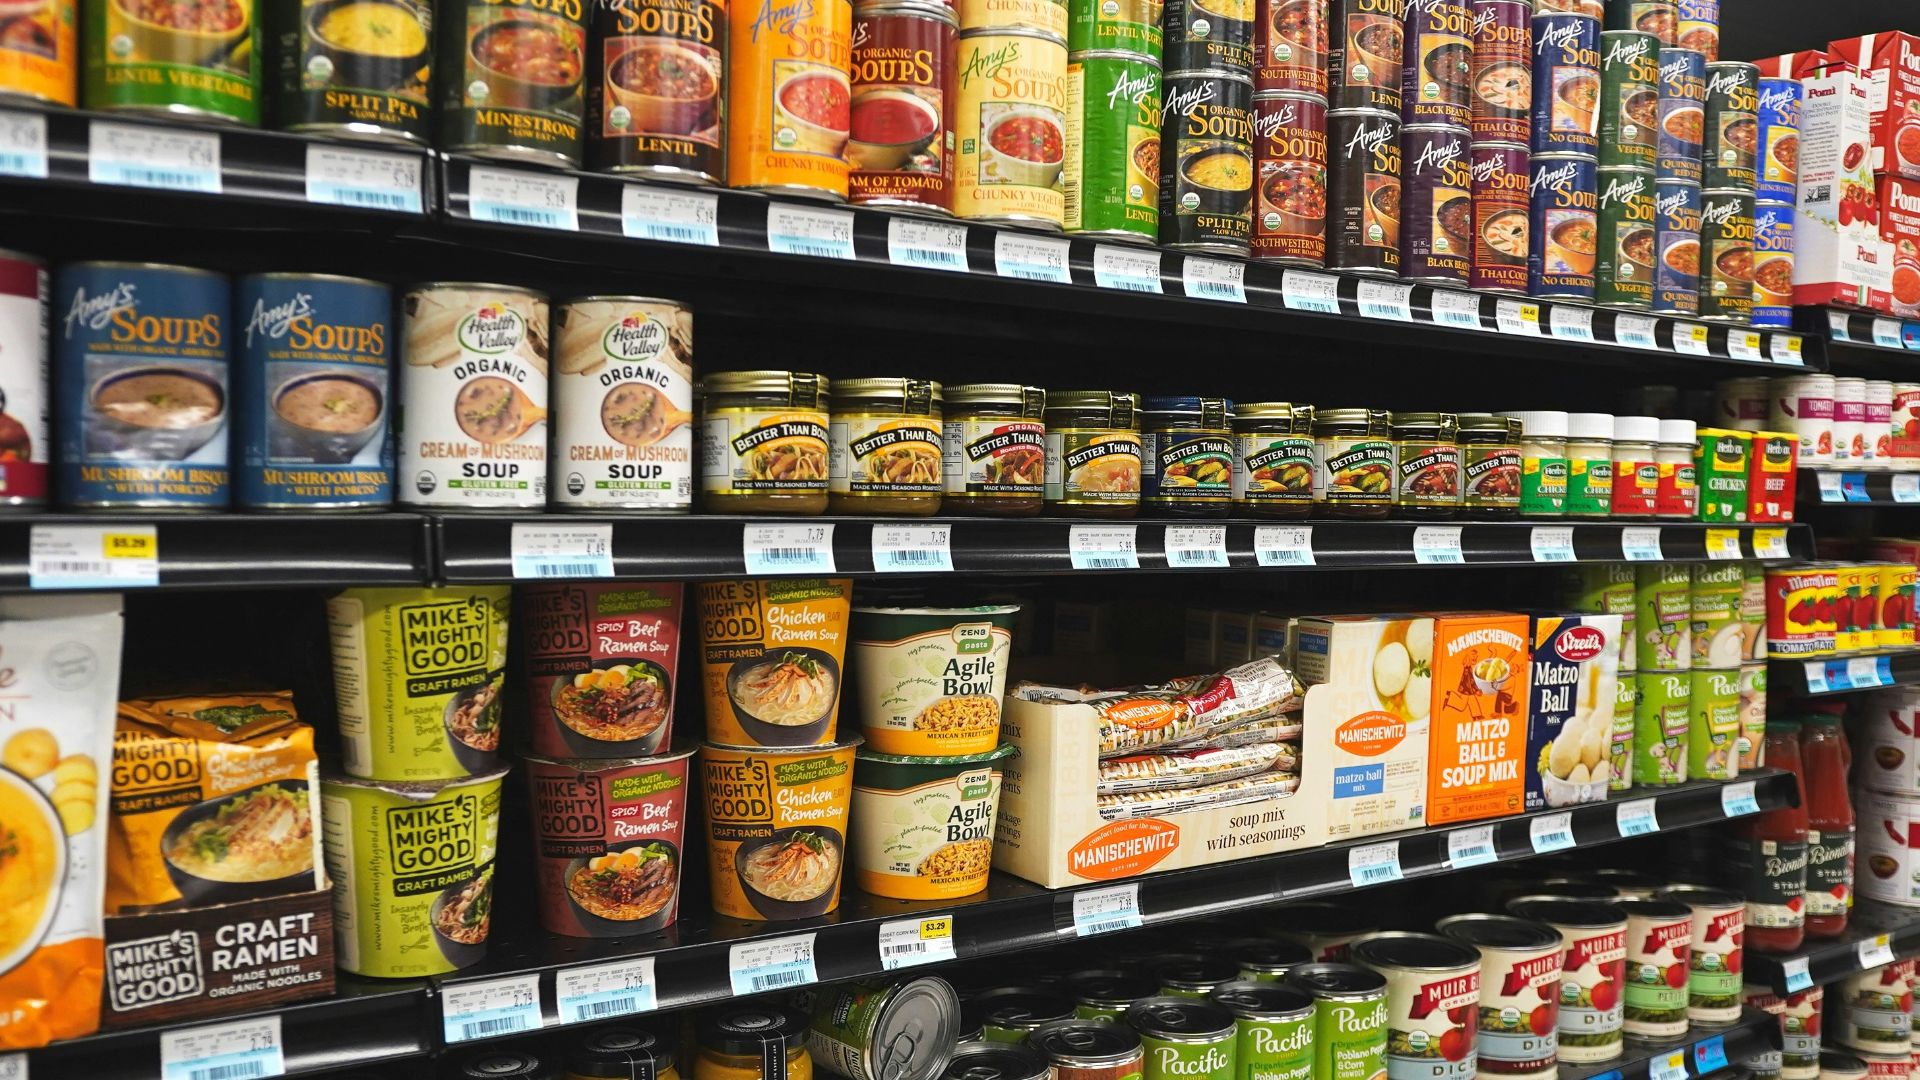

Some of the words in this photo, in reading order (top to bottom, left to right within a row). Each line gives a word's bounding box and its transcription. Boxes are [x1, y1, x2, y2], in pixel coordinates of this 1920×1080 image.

[617, 3, 713, 43] SOUPS
[1097, 24, 1138, 39] LENTIL
[1536, 19, 1585, 56] Amy's
[863, 47, 911, 59] ORGANIC
[1207, 43, 1241, 62] SPLIT
[850, 50, 933, 84] SOUPS
[992, 65, 1065, 108] SOUPS
[1107, 68, 1157, 110] Amy's
[1705, 69, 1748, 100] Amy's
[325, 91, 380, 111] SPLIT
[387, 96, 418, 119] PEA
[1210, 106, 1246, 120] ORGANIC
[1415, 105, 1443, 115] BLACK
[1473, 122, 1500, 133] THAI
[638, 138, 697, 156] LENTIL
[1549, 133, 1562, 143] NO
[765, 156, 813, 171] CHUNKY
[873, 177, 889, 187] OF
[893, 176, 943, 191] TOMATO
[972, 188, 1026, 201] CHUNKY
[1126, 208, 1154, 222] LENTIL
[1197, 215, 1233, 230] SPLIT
[832, 230, 849, 242] 5.19
[947, 235, 962, 246] 5.19
[1251, 237, 1314, 250] SOUTHWESTERN
[1427, 257, 1453, 268] BLACK
[1479, 269, 1506, 279] THAI
[1542, 276, 1557, 286] NO
[64, 282, 137, 339] Amy's
[111, 306, 221, 347] SOUPS
[245, 293, 313, 348] Amy's
[467, 315, 515, 333] Health
[290, 316, 385, 356] SOUPS
[612, 323, 658, 341] Health
[622, 340, 660, 356] Valley
[454, 359, 527, 383] ORGANIC
[600, 365, 669, 388] ORGANIC
[1008, 424, 1042, 433] ORGANIC
[736, 429, 778, 453] BETTER
[782, 424, 809, 436] THAN
[855, 434, 895, 456] BETTER
[898, 429, 924, 440] THAN
[970, 437, 1008, 457] BETTER
[1011, 432, 1034, 443] THAN
[420, 442, 468, 458] CREAM
[570, 445, 613, 461] CREAM
[1068, 446, 1107, 466] BETTER
[1110, 443, 1131, 453] THAN
[1163, 446, 1199, 465] BETTER
[1201, 442, 1222, 452] THAN
[1249, 452, 1284, 470] BETTER
[1286, 447, 1306, 457] THAN
[1367, 450, 1385, 459] THAN
[462, 462, 519, 479] SOUP
[608, 464, 662, 479] SOUP
[1403, 457, 1435, 474] BETTER
[1437, 453, 1454, 463] THAN
[1468, 458, 1500, 476] BETTER
[1501, 457, 1517, 465] THAN
[82, 467, 184, 484] MUSHROOM
[263, 470, 355, 486] MUSHROOM
[461, 480, 495, 489] GLUTEN
[1708, 478, 1746, 490] CHICKEN
[1765, 478, 1785, 490] BEEF
[115, 483, 156, 495] WITH
[295, 485, 331, 496] WITH
[608, 481, 641, 490] GLUTEN
[113, 538, 146, 548] $5.29
[808, 529, 824, 541] 7.79
[931, 531, 946, 542] 7.79
[770, 590, 809, 601] ORGANIC
[408, 601, 484, 628] MIKE'S
[767, 606, 826, 626] Chicken
[410, 624, 485, 647] MIGHTY
[597, 622, 624, 633] SPICY
[629, 620, 660, 637] Beef
[705, 618, 757, 638] GOOD
[771, 625, 817, 641] Ramen
[961, 628, 986, 638] ZENB
[599, 637, 648, 653] Ramen
[965, 641, 988, 651] pasta
[1447, 628, 1523, 657] MANISCHEWITZ
[413, 642, 483, 669] GOOD
[729, 648, 763, 659] RAMEN
[943, 656, 995, 683] Agile
[1534, 662, 1578, 686] Matzo
[410, 679, 448, 694] CRAFT
[451, 673, 487, 688] RAMEN
[943, 677, 993, 696] Bowl
[1541, 688, 1569, 713] Ball
[1547, 716, 1561, 725] Mix
[1339, 724, 1404, 742] MANISCHEWITZ
[1456, 718, 1510, 743] MATZO
[1459, 744, 1496, 765] BALL
[1498, 742, 1505, 757] &
[112, 760, 193, 787] GOOD
[780, 763, 806, 773] MADE
[807, 760, 827, 771] WITH
[1442, 766, 1485, 789] SOUP
[1488, 759, 1518, 781] MIX
[211, 771, 263, 791] Ramen
[614, 776, 640, 788] MADE
[642, 773, 662, 785] WITH
[778, 772, 818, 783] ORGANIC
[1336, 772, 1364, 785] matzo
[968, 787, 988, 796] pasta
[1353, 784, 1365, 792] mix
[777, 788, 832, 807] Chicken
[394, 797, 472, 829] MIKE'S
[611, 806, 638, 818] SPICY
[643, 800, 672, 819] Beef
[711, 799, 767, 818] GOOD
[947, 801, 992, 826] Agile
[1229, 813, 1260, 830] soup
[1262, 807, 1285, 823] mix
[396, 821, 472, 848] MIGHTY
[614, 820, 660, 837] Ramen
[713, 828, 736, 838] CRAFT
[737, 827, 772, 838] RAMEN
[947, 820, 990, 842] Bowl
[1207, 834, 1236, 851] with
[1239, 823, 1306, 848] seasonings
[399, 840, 472, 869] GOOD
[1074, 829, 1177, 870] MANISCHEWITZ
[397, 877, 435, 892] CRAFT
[438, 871, 474, 886] RAMEN
[926, 922, 946, 931] $3.29
[1719, 911, 1744, 929] MUIR
[216, 912, 314, 948] CRAFT
[1658, 923, 1689, 941] MUIR
[112, 930, 193, 968] MIKE'S
[212, 935, 319, 972] RAMEN
[1581, 936, 1615, 956] MUIR
[795, 951, 811, 962] 2.79
[115, 956, 194, 985] MIGHTY
[233, 969, 266, 983] MADE
[269, 965, 300, 977] WITH
[1521, 958, 1552, 979] MUIR
[119, 973, 195, 1004] GOOD
[209, 981, 265, 998] ORGANIC
[267, 971, 322, 988] NOODLES
[624, 976, 643, 990] 2.79
[1429, 980, 1466, 1002] MUIR
[1331, 1006, 1390, 1033] Pacific
[1249, 1024, 1313, 1054] Pacific
[1155, 1047, 1229, 1075] Pacific
[1337, 1048, 1369, 1060] Poblano
[1345, 1060, 1365, 1070] Corn
